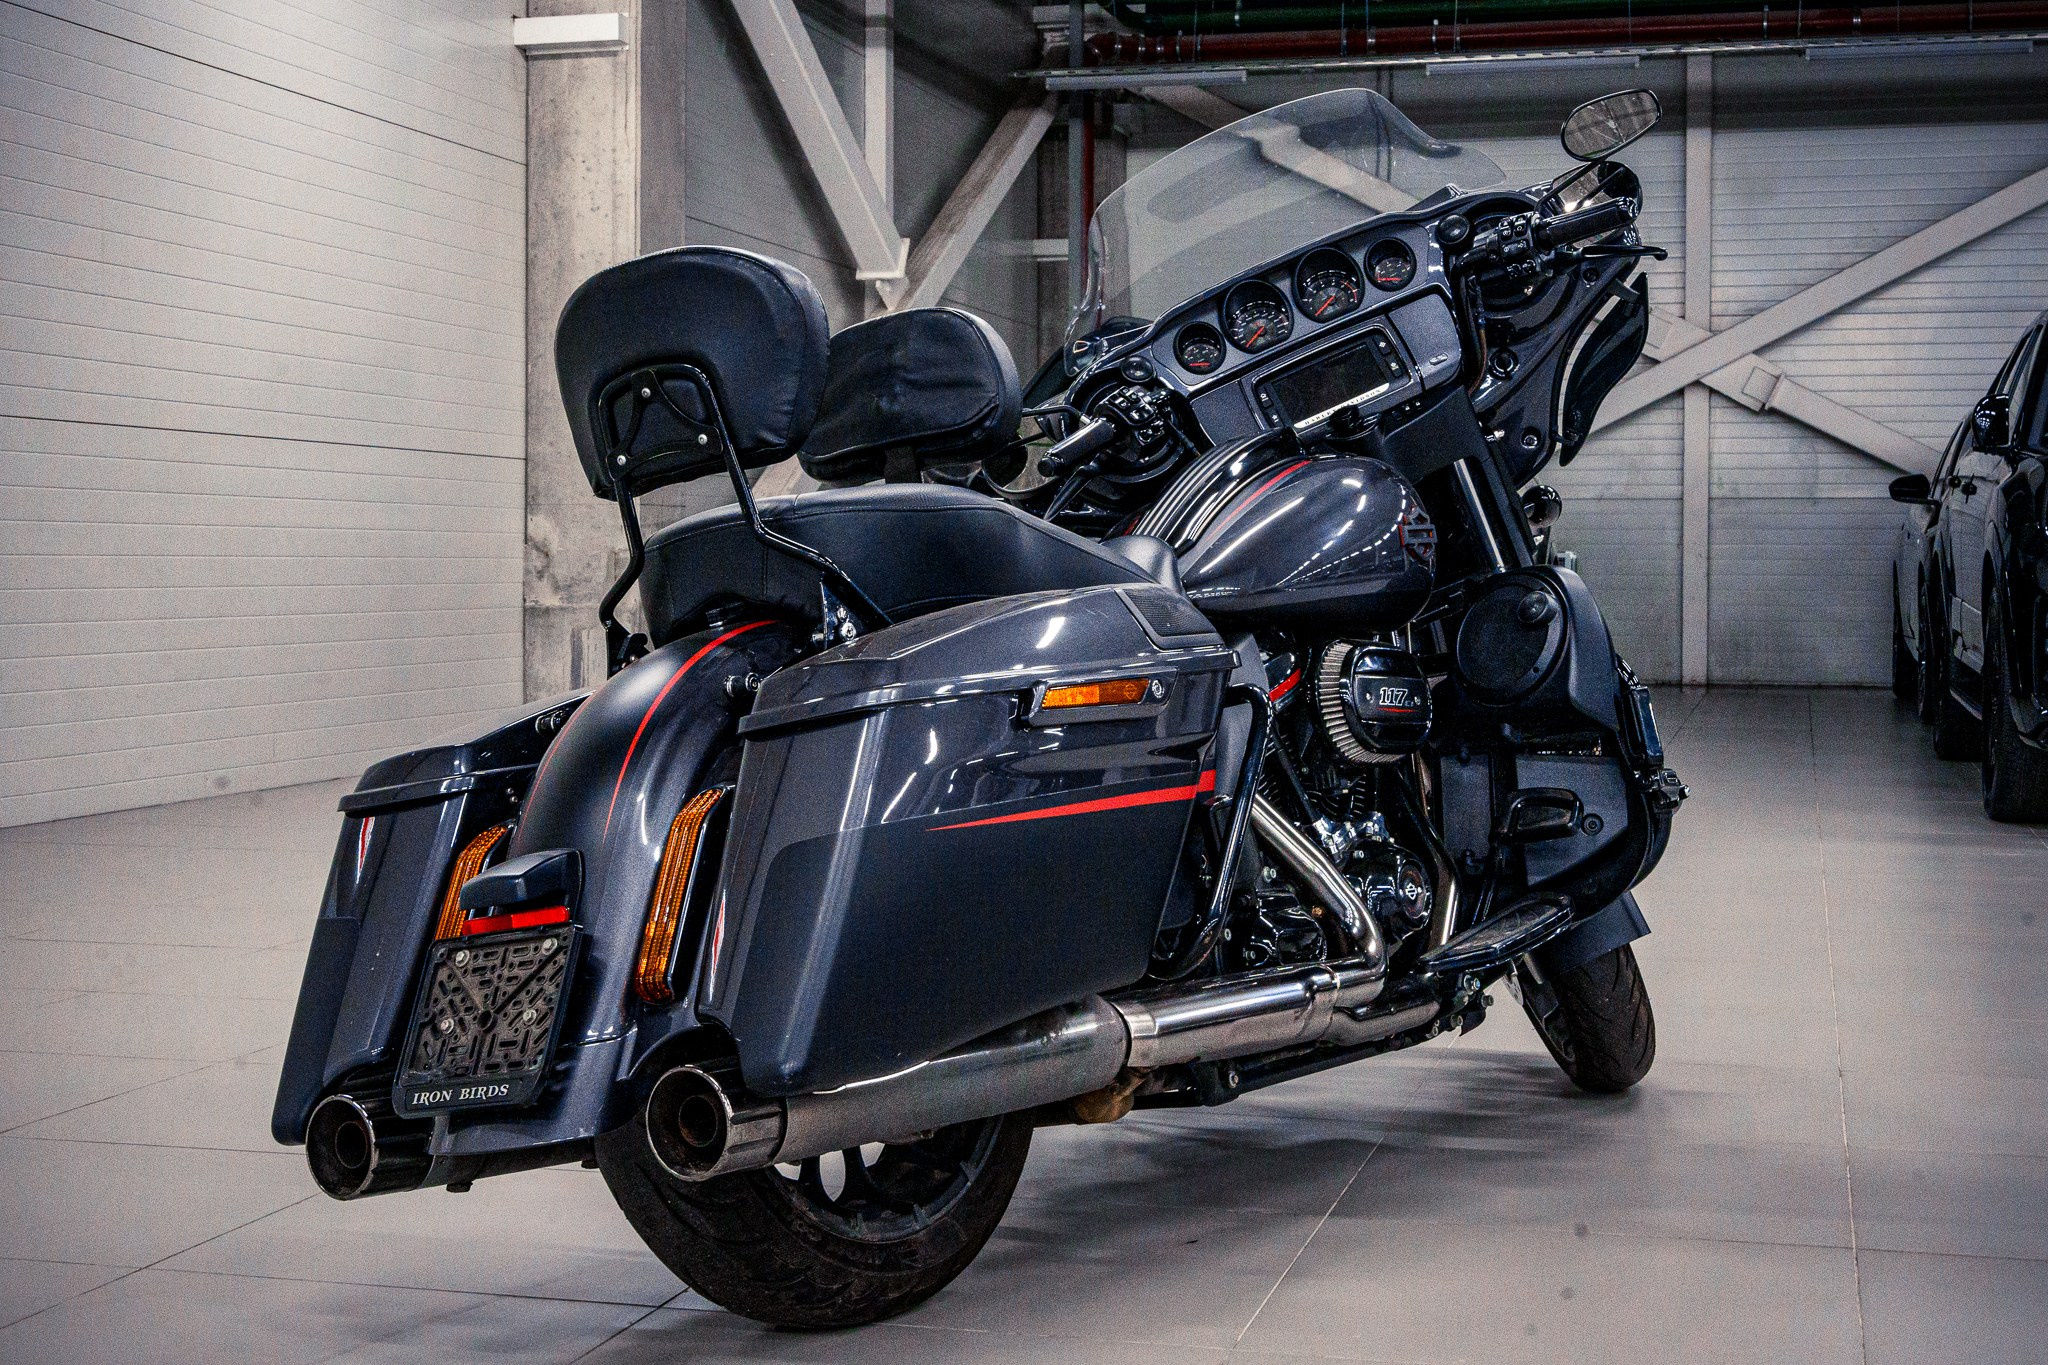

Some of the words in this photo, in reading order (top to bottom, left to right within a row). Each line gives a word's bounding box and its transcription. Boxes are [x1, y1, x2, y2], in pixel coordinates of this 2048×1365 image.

[1379, 687, 1408, 706] 117
[412, 1089, 453, 1105] IRON
[459, 1084, 509, 1100] BIRDS
